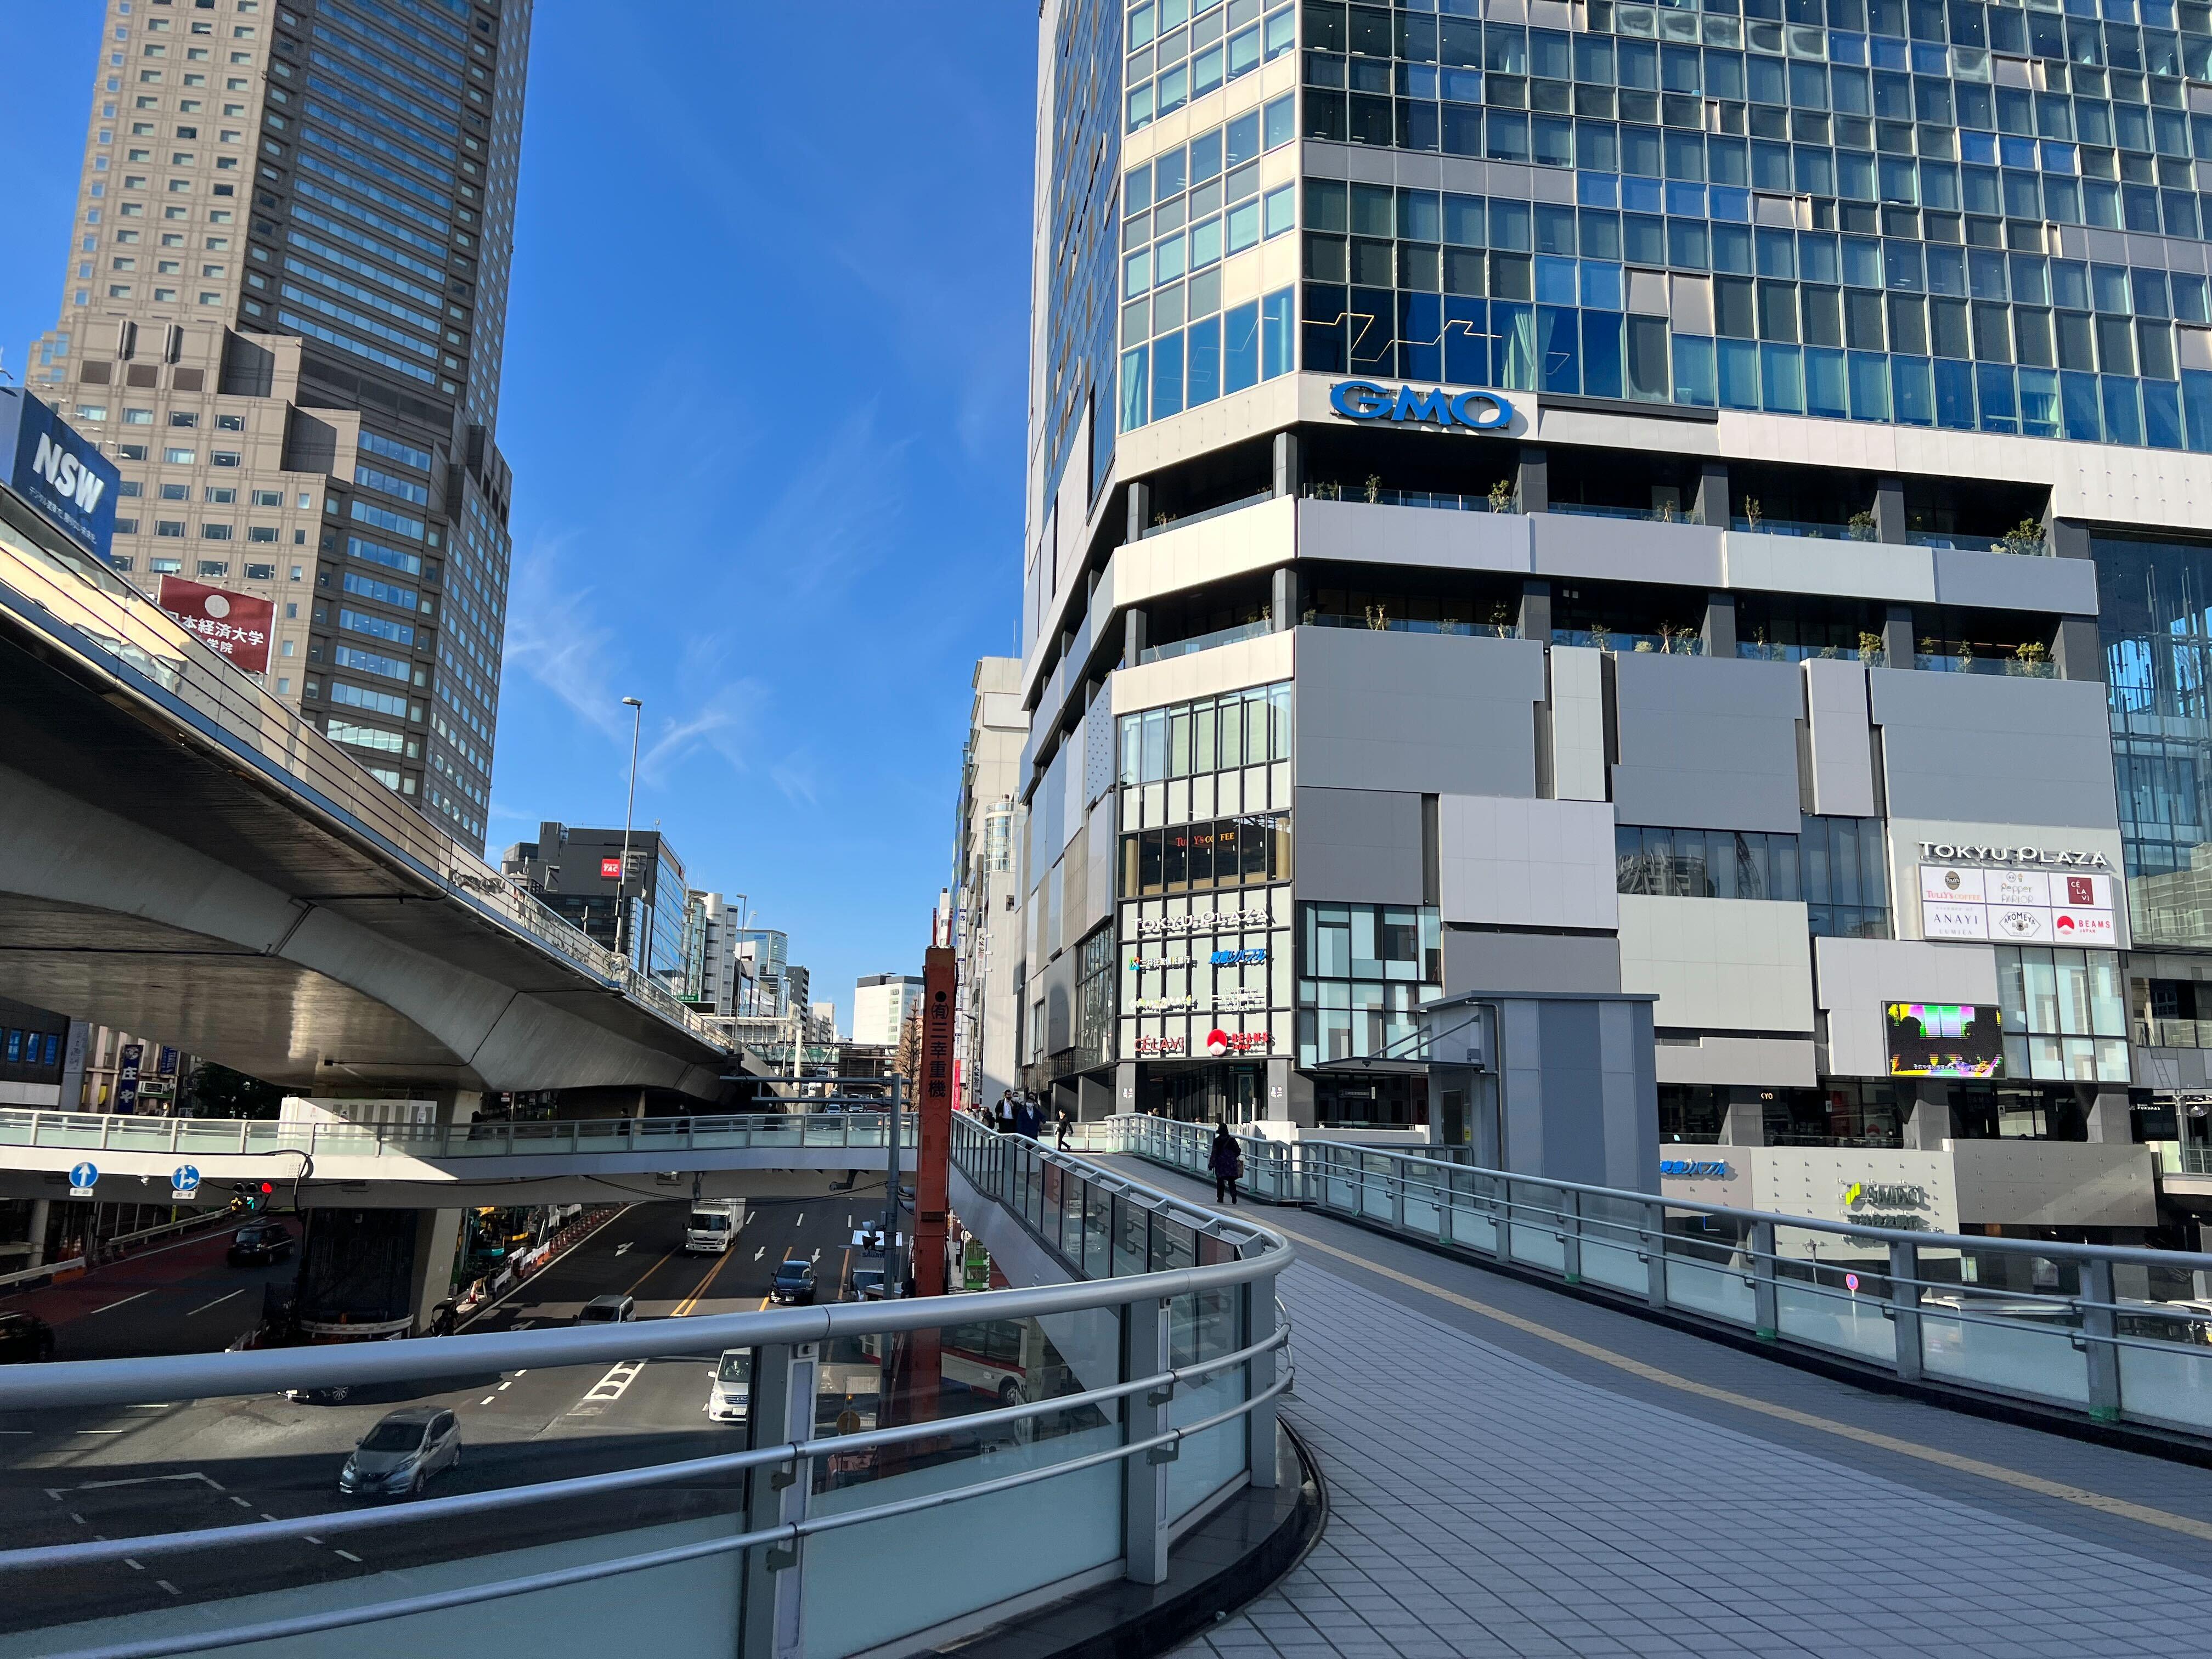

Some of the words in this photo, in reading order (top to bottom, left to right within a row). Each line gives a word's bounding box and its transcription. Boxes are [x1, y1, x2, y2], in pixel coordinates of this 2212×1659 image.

[1330, 381, 1513, 429] GMO
[32, 432, 105, 514] NSW
[1205, 832, 1235, 843] COFEE
[1919, 842, 2008, 860] TOKYU
[2018, 847, 2107, 866] PLAZA
[2070, 880, 2080, 888] CÉ
[2001, 895, 2034, 905] PARLOR
[1131, 915, 1194, 931] TOKYU
[1201, 909, 1269, 926] PLAZA
[1934, 913, 1978, 925] ANAYI
[2004, 912, 2035, 926] AKOMEYA
[2079, 920, 2111, 928] BEAMS
[1232, 1032, 1268, 1043] BEAMS
